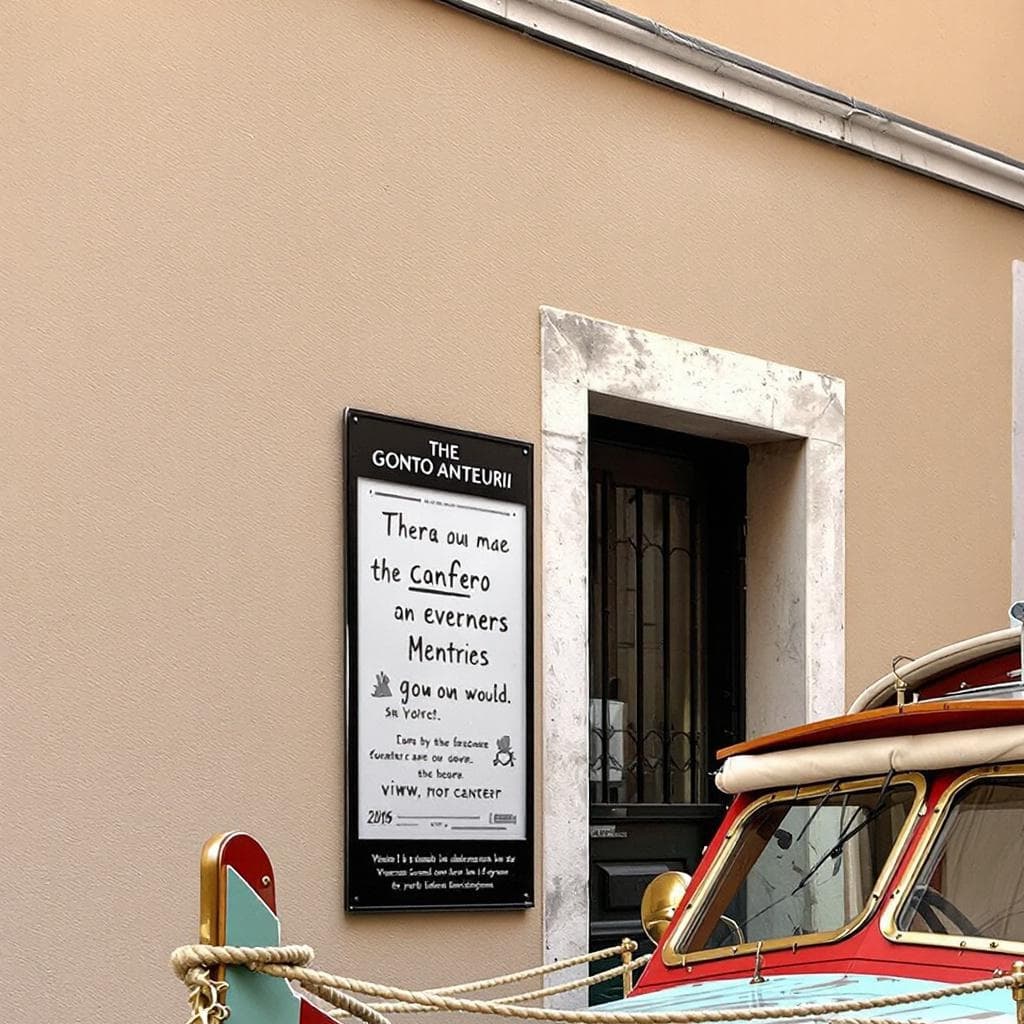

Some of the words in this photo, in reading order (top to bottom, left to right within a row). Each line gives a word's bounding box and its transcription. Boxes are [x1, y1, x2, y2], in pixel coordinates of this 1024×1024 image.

[428, 440, 460, 460] THE
[372, 449, 434, 475] GONTO
[437, 462, 512, 489] ANTEURII
[381, 511, 439, 543] Thera
[476, 535, 510, 553] mae
[370, 558, 401, 583] the
[409, 559, 491, 592] Canfero
[394, 605, 415, 621] an
[424, 607, 509, 633] everners
[408, 635, 489, 666] Mentries
